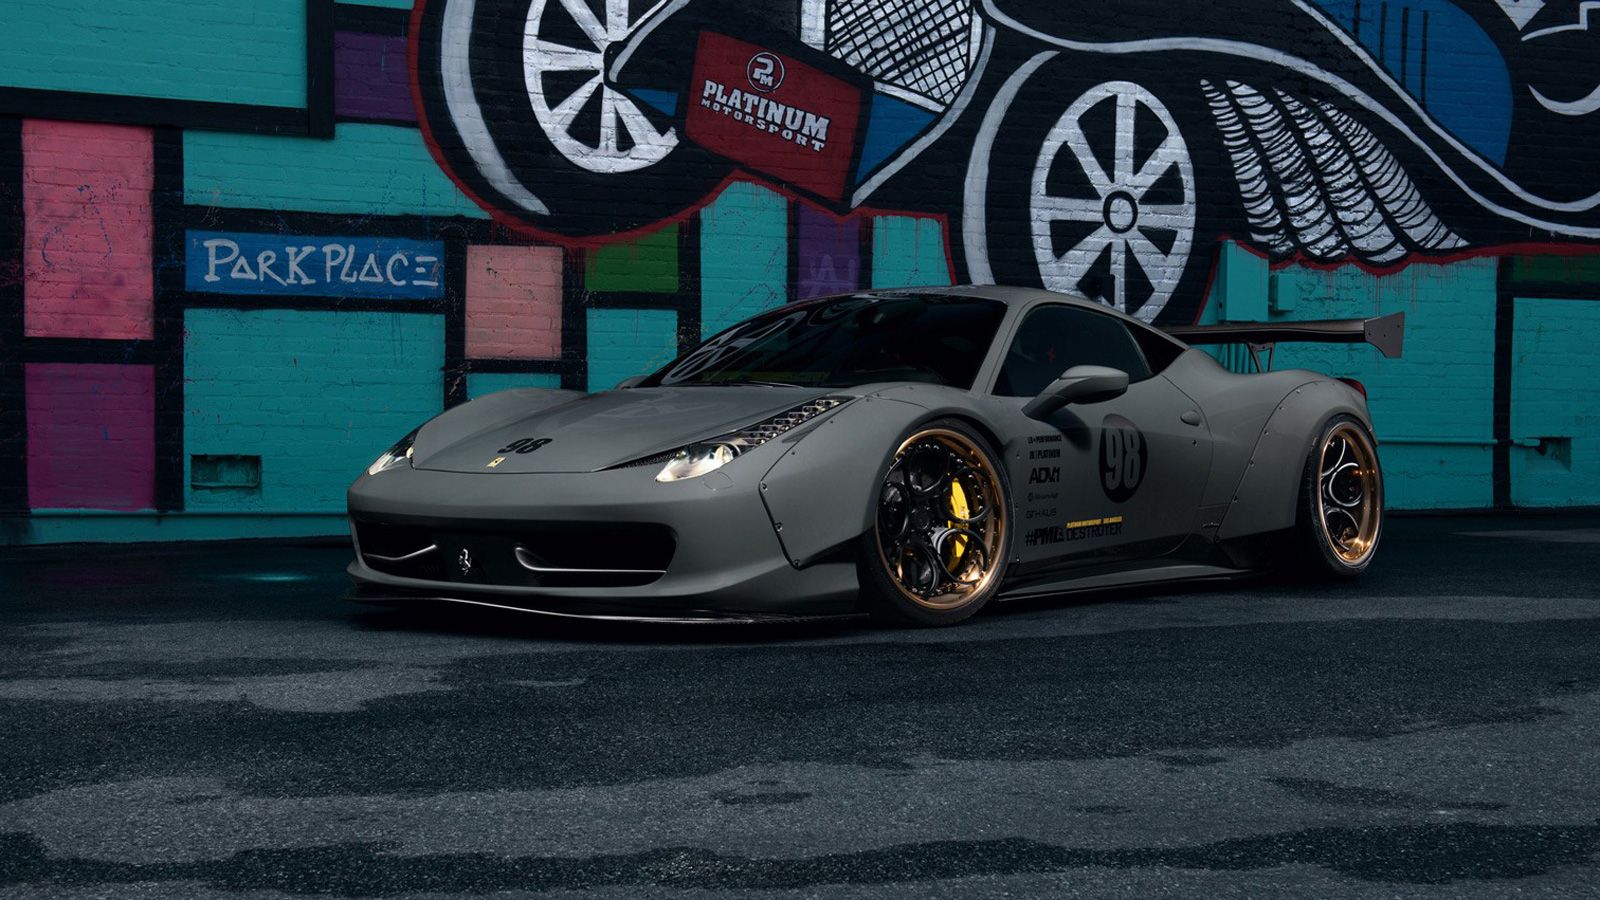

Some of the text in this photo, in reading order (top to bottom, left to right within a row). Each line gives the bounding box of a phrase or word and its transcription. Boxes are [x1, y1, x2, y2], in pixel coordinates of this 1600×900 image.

[700, 98, 825, 152] MOTORSPORT
[702, 79, 831, 141] PLATINUM
[203, 238, 439, 287] PARK PLACE
[497, 437, 553, 454] 98
[1105, 426, 1141, 491] 98
